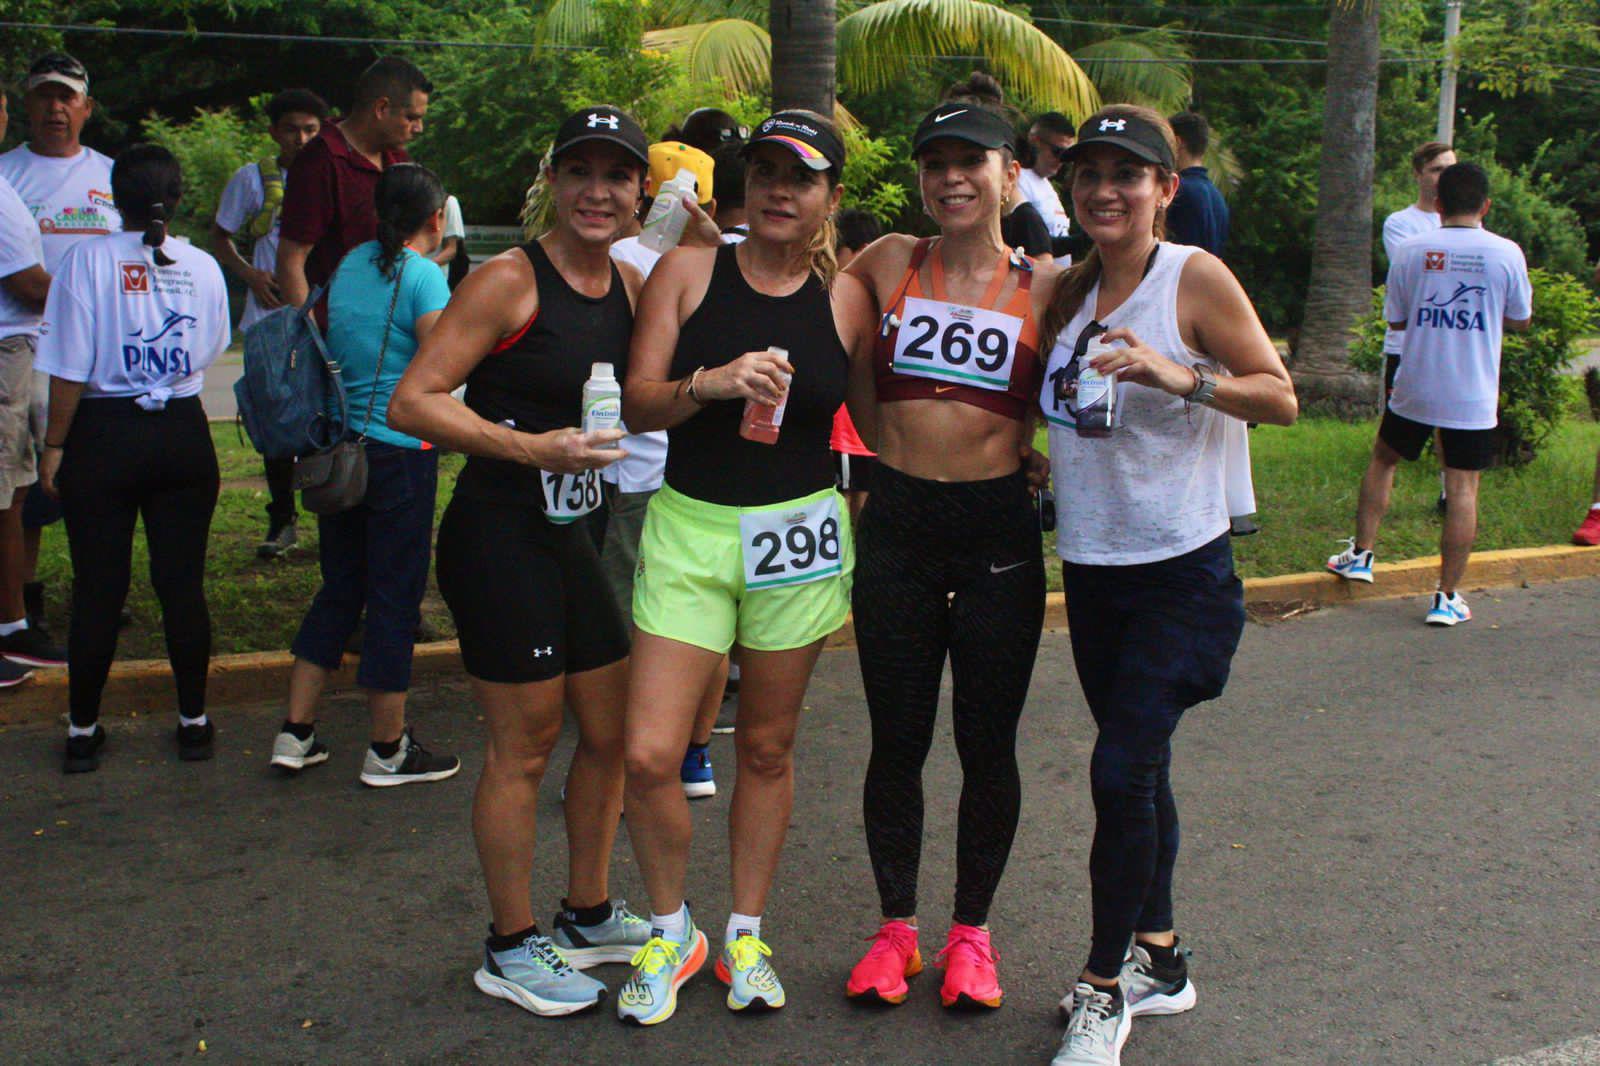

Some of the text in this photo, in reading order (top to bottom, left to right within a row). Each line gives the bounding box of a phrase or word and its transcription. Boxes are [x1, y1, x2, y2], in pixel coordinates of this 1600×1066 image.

[902, 315, 1009, 372] 269
[1416, 307, 1485, 332] PINSA
[751, 516, 839, 576] 298
